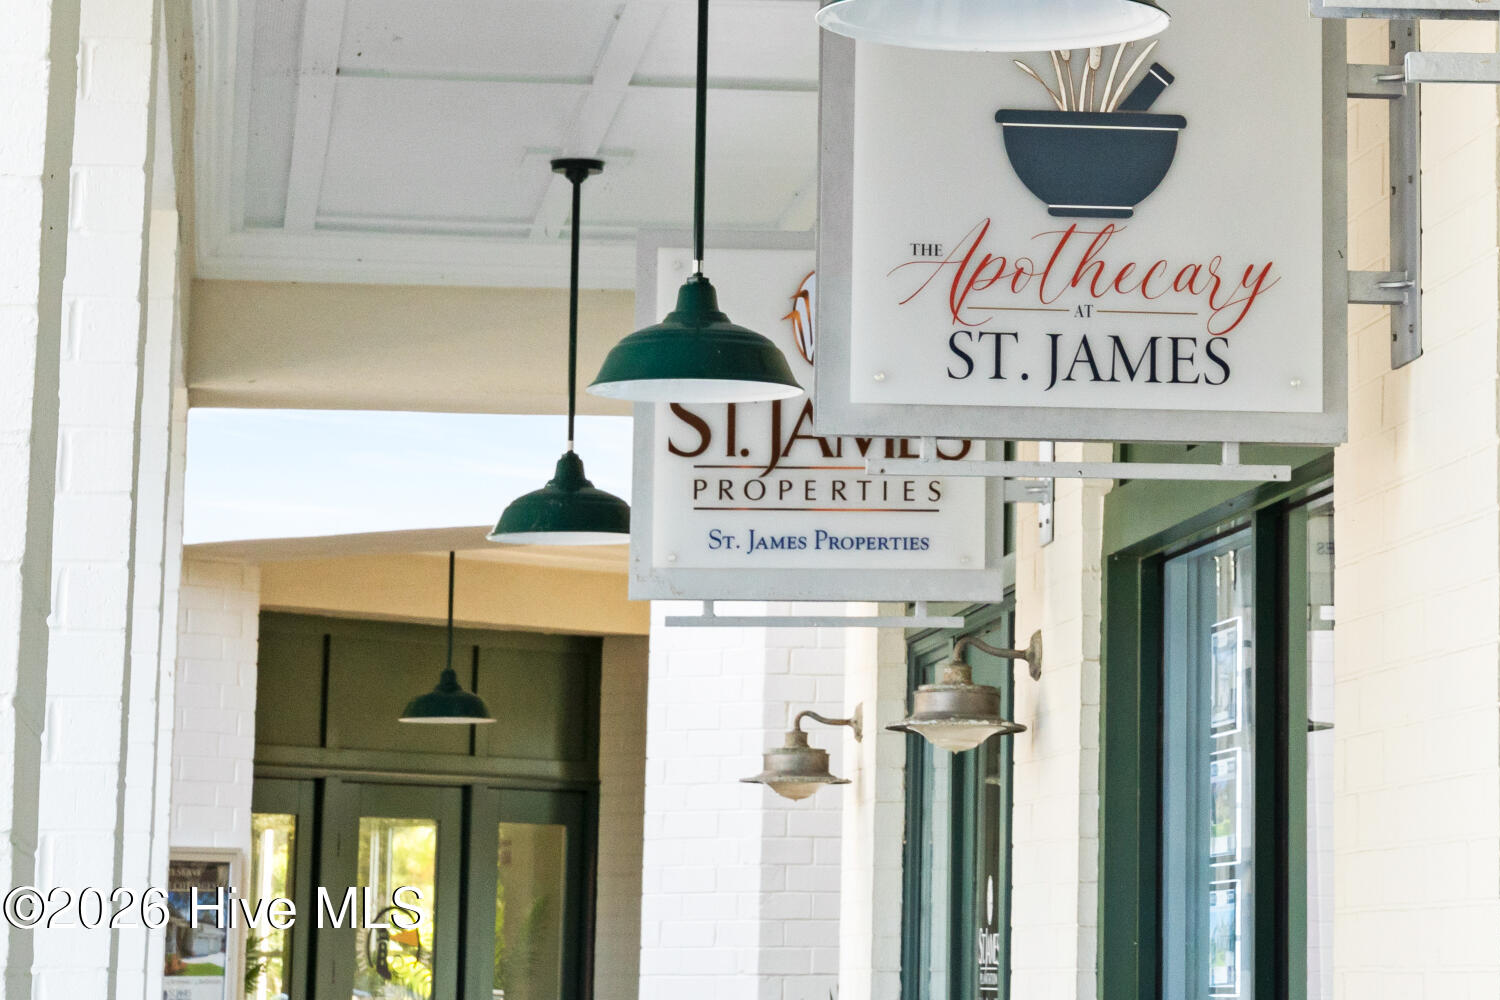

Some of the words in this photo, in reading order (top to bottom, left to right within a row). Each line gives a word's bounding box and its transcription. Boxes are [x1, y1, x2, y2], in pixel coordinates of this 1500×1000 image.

[909, 242, 943, 258] THE
[887, 217, 1282, 337] Apothecary
[1074, 303, 1094, 319] AT
[946, 329, 1029, 381] ST.
[1043, 331, 1232, 392] JAMES
[693, 478, 942, 503] PROPERTIES
